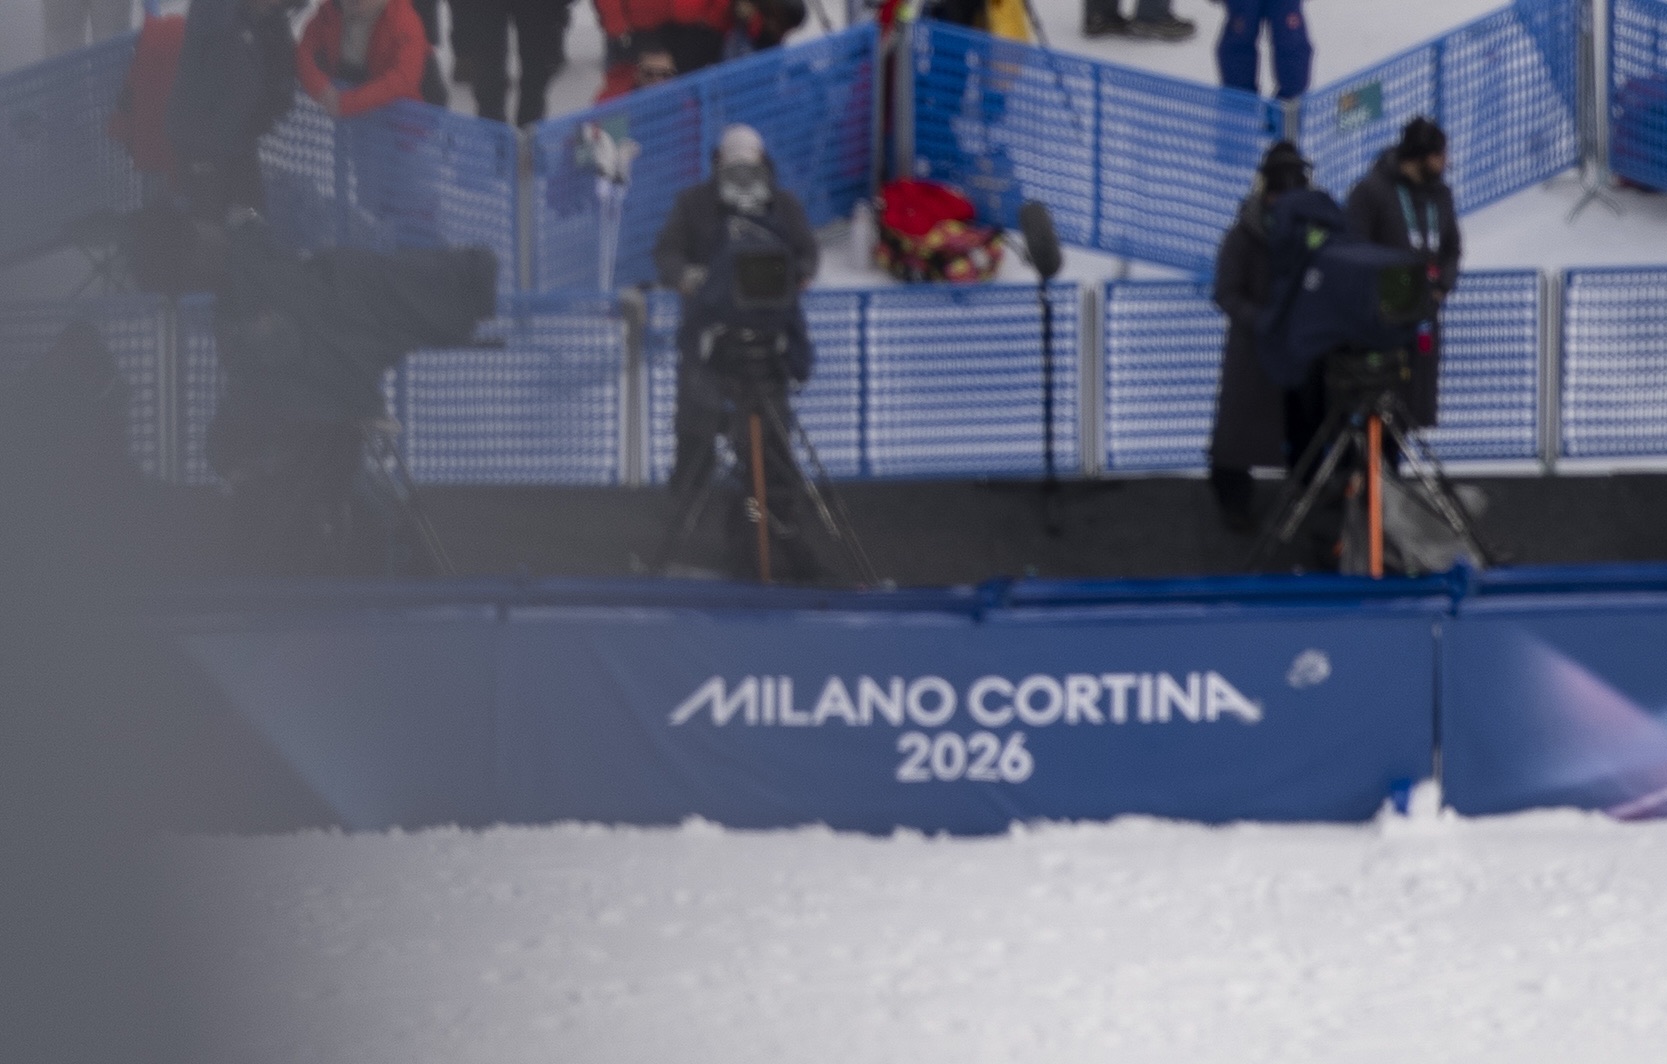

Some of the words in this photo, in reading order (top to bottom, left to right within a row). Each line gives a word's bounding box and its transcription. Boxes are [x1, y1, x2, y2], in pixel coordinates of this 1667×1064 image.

[668, 675, 957, 727] MILANO
[967, 672, 1262, 724] CORTINA
[896, 731, 1034, 783] 2026
